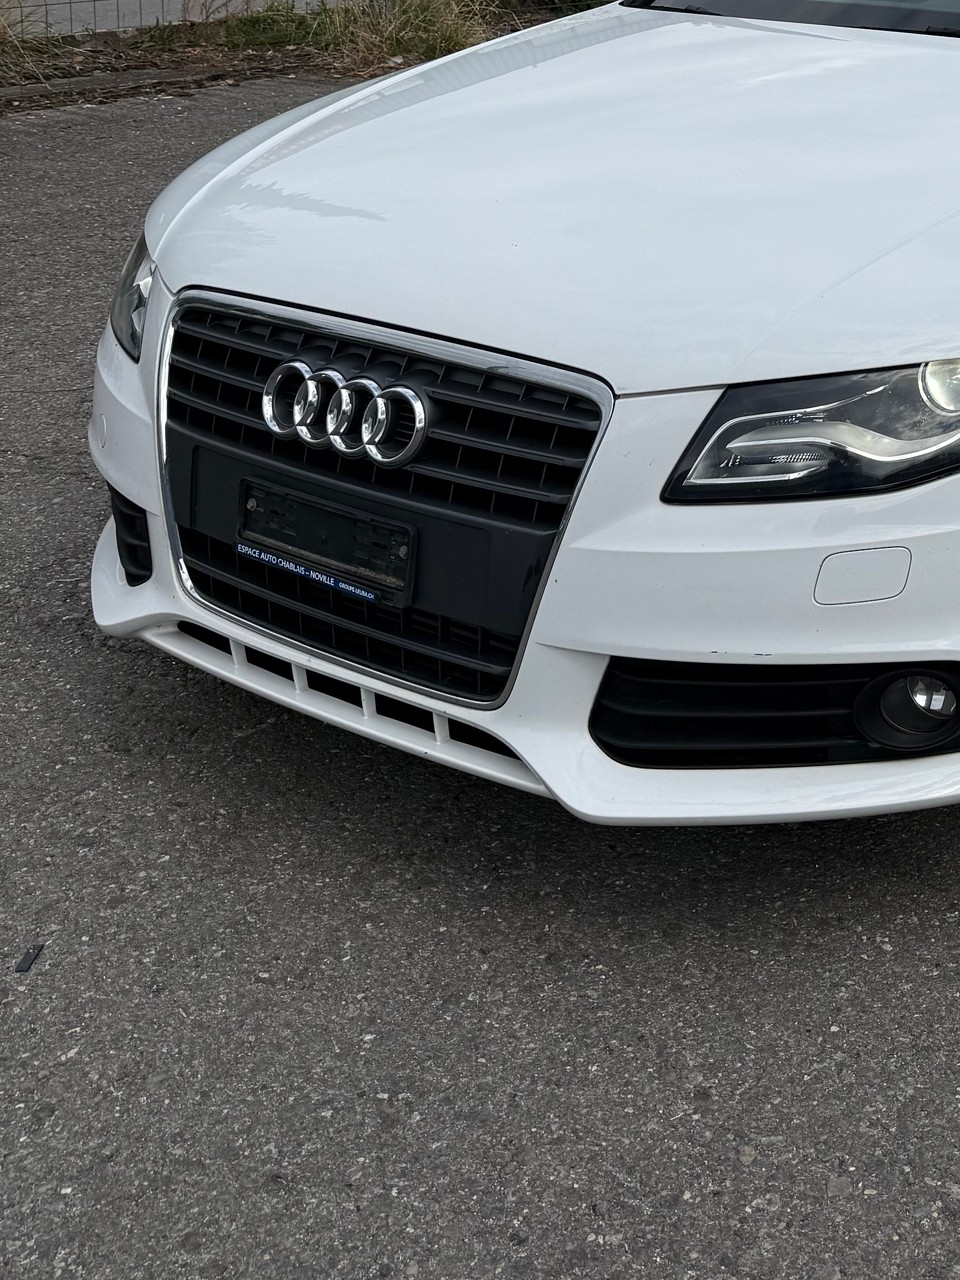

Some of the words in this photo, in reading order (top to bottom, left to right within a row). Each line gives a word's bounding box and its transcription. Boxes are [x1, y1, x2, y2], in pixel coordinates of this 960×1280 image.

[237, 544, 260, 558] ESPACE
[260, 552, 277, 564] AUTO
[278, 558, 305, 575] CHABLAIS
[310, 570, 335, 586] NOVILLE
